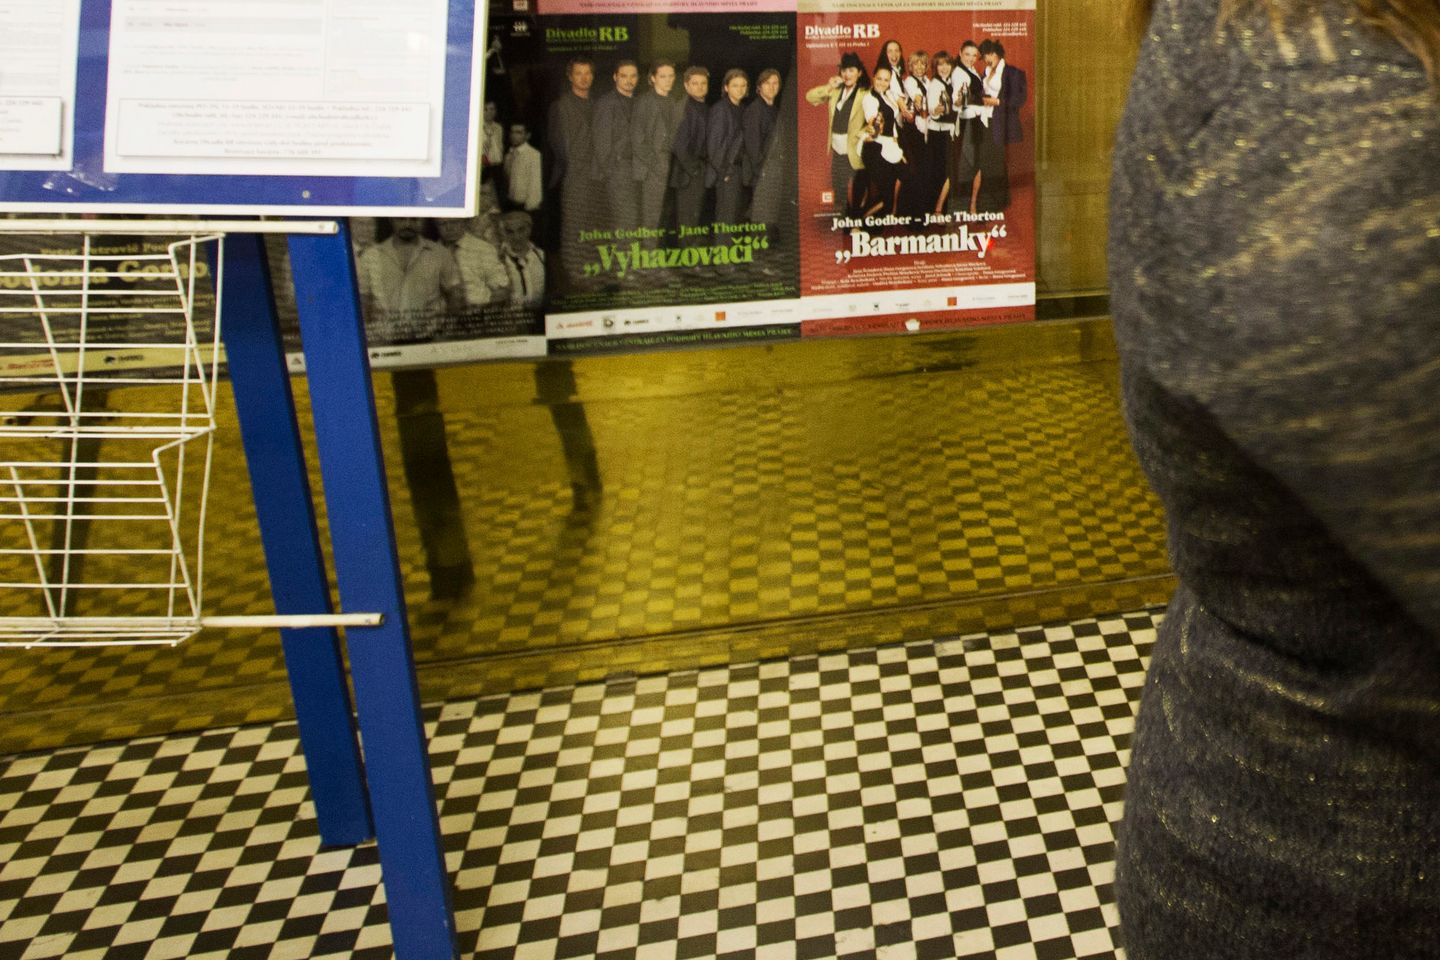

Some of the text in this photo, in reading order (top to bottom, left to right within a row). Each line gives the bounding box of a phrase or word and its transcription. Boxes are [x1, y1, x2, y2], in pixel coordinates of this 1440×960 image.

[545, 26, 630, 42] Divadlo RB
[804, 24, 852, 37] Divadlo
[853, 23, 881, 39] RB
[831, 217, 863, 231] John
[865, 215, 912, 228] Godber
[924, 213, 952, 226] Jane
[953, 211, 1005, 223] Thorton
[579, 229, 612, 241] John
[614, 227, 666, 239] Godber
[678, 225, 710, 238] Jane
[711, 222, 767, 235] Thorton
